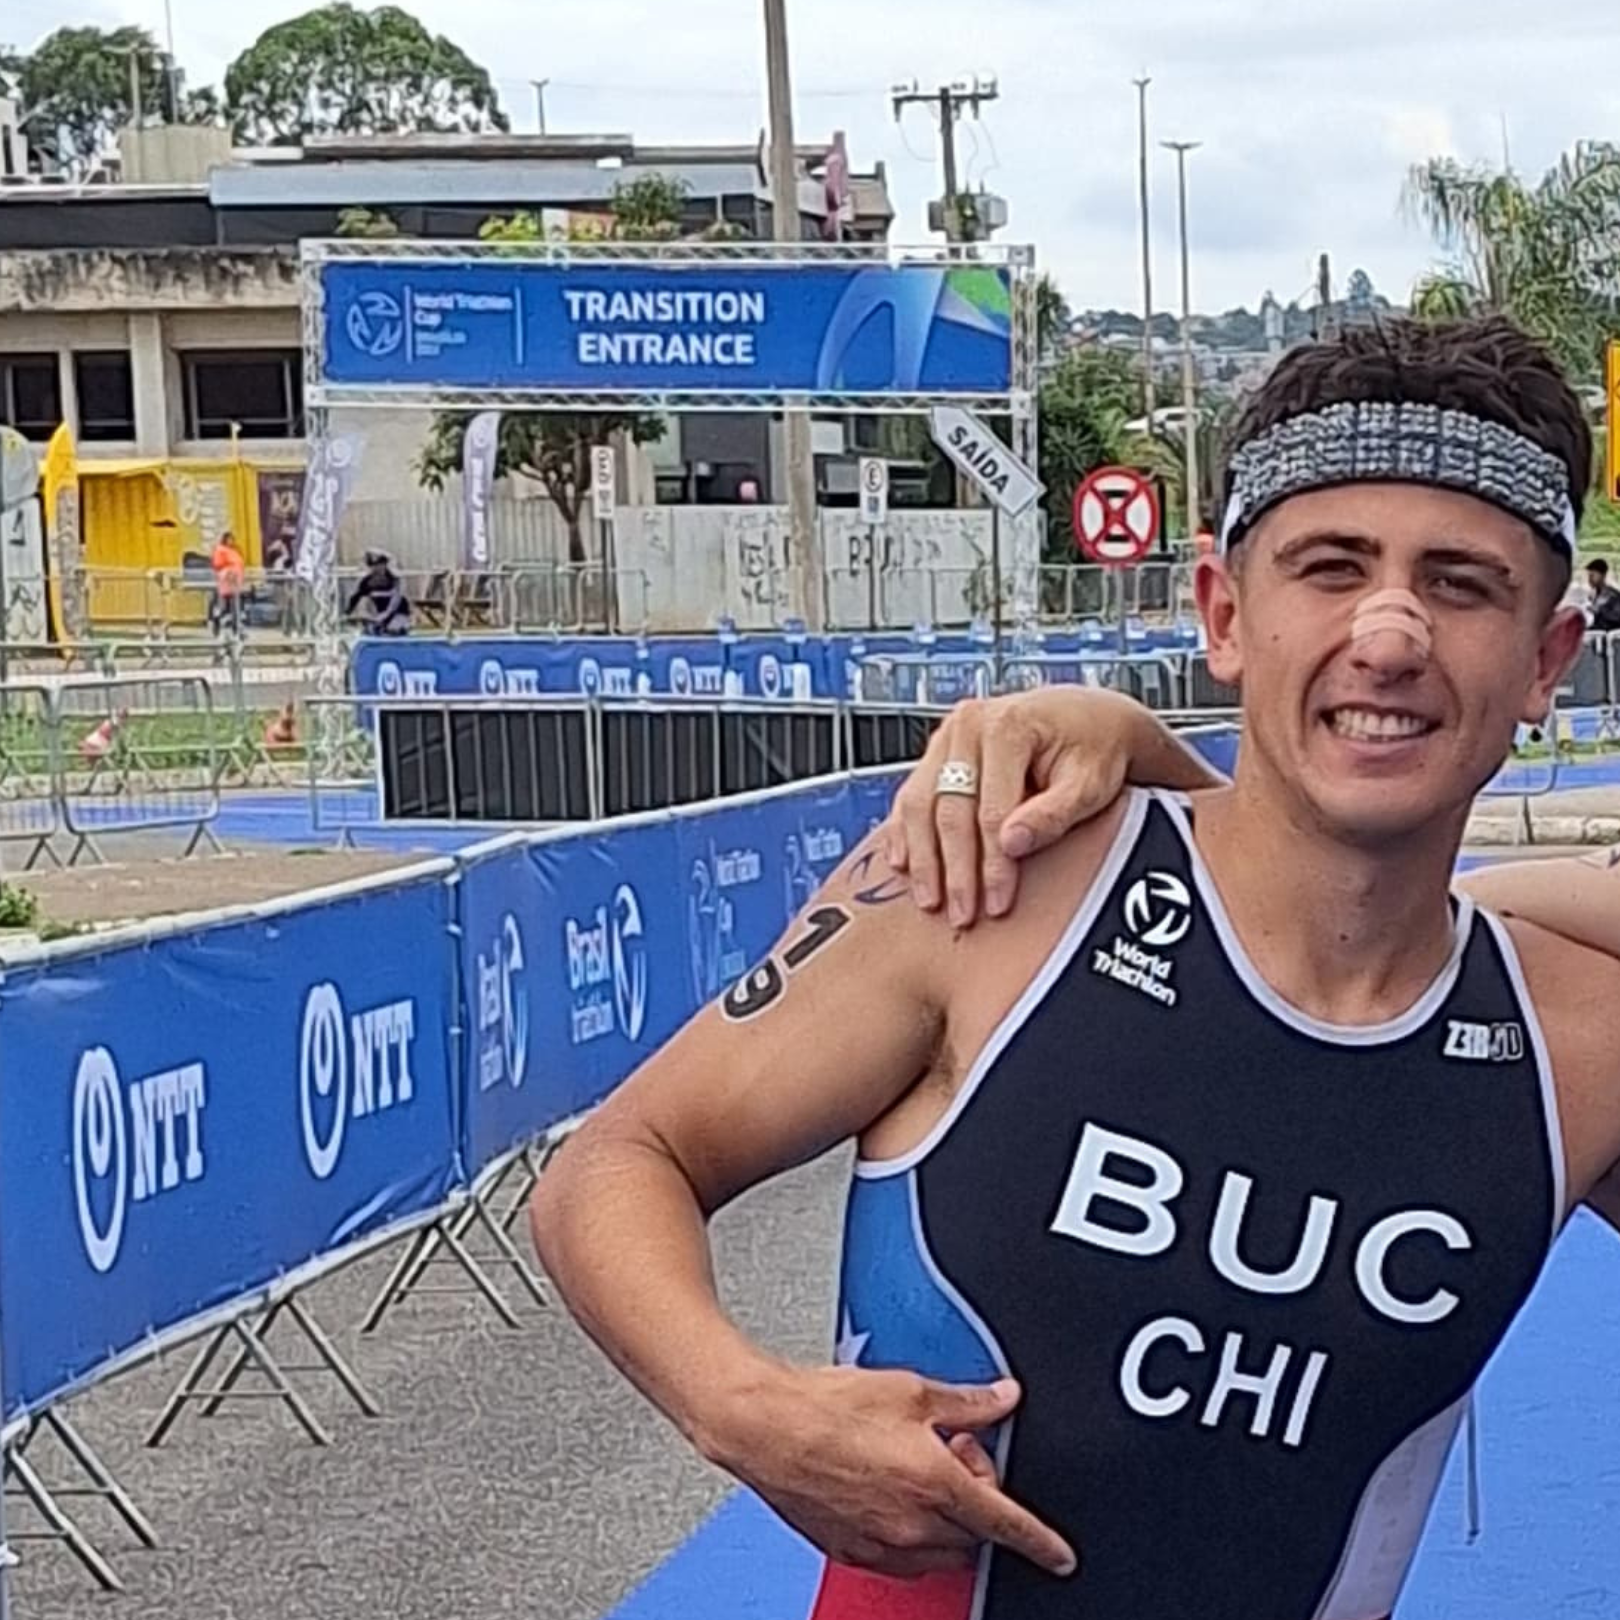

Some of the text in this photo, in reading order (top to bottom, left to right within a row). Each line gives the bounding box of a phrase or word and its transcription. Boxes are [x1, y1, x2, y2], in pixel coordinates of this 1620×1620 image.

[564, 290, 765, 323] TRANSITION
[578, 333, 755, 364] ENTRANCE
[947, 425, 1009, 495] SAÍDA
[1113, 936, 1172, 980] World
[352, 999, 413, 1119] NTT
[129, 1062, 205, 1201] NTT
[1050, 1121, 1472, 1323] BUC
[1119, 1316, 1328, 1447] CHI
